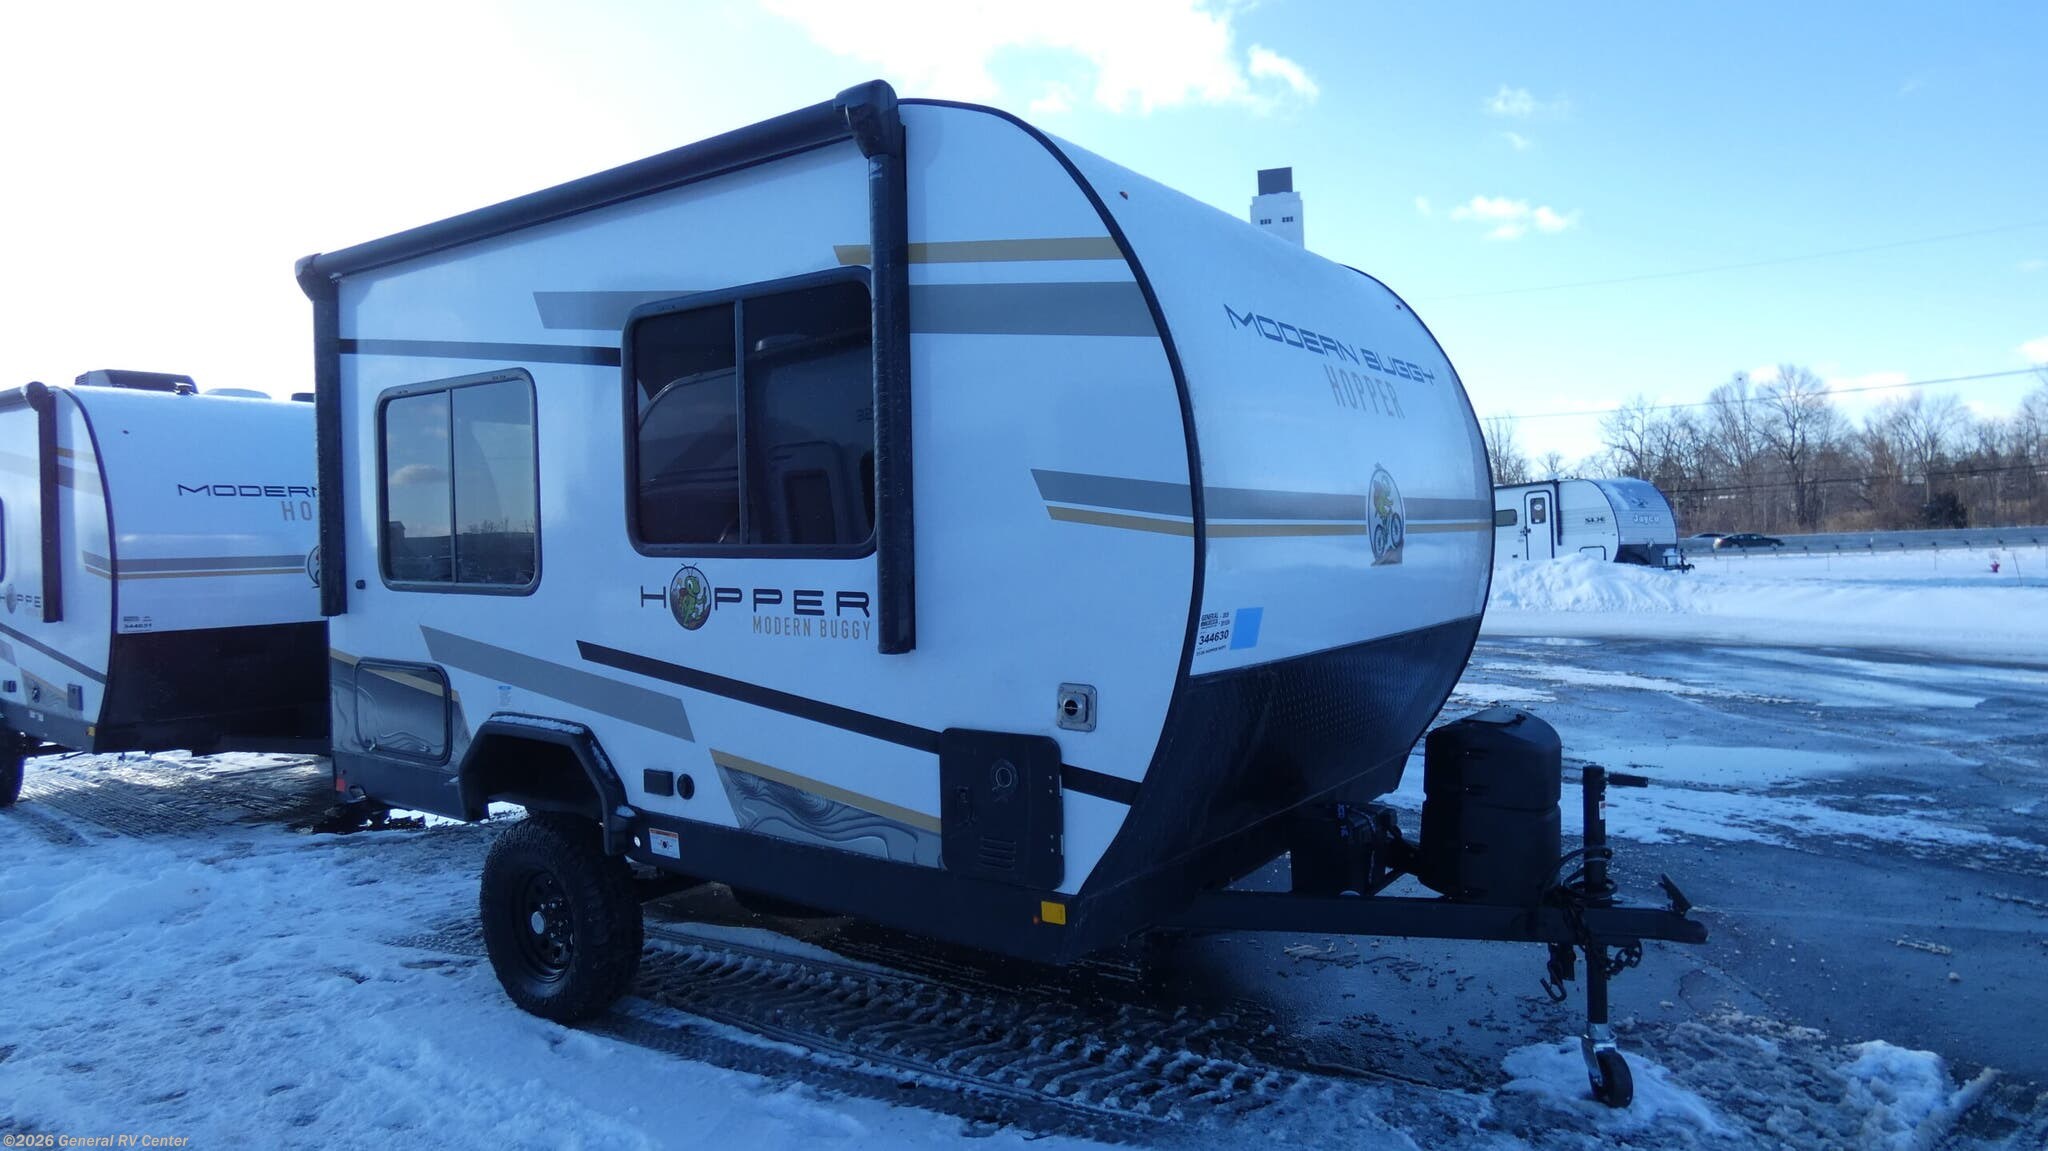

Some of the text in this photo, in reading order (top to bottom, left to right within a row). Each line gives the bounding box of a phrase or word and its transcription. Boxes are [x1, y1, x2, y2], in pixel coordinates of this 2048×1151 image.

[1223, 303, 1436, 385] MODERN BUGGY
[1323, 363, 1406, 419] HOPPER
[177, 484, 318, 498] MODER
[1633, 514, 1660, 525] Jayco
[752, 615, 871, 641] MODERN BUGGY
[1199, 629, 1229, 645] 344630
